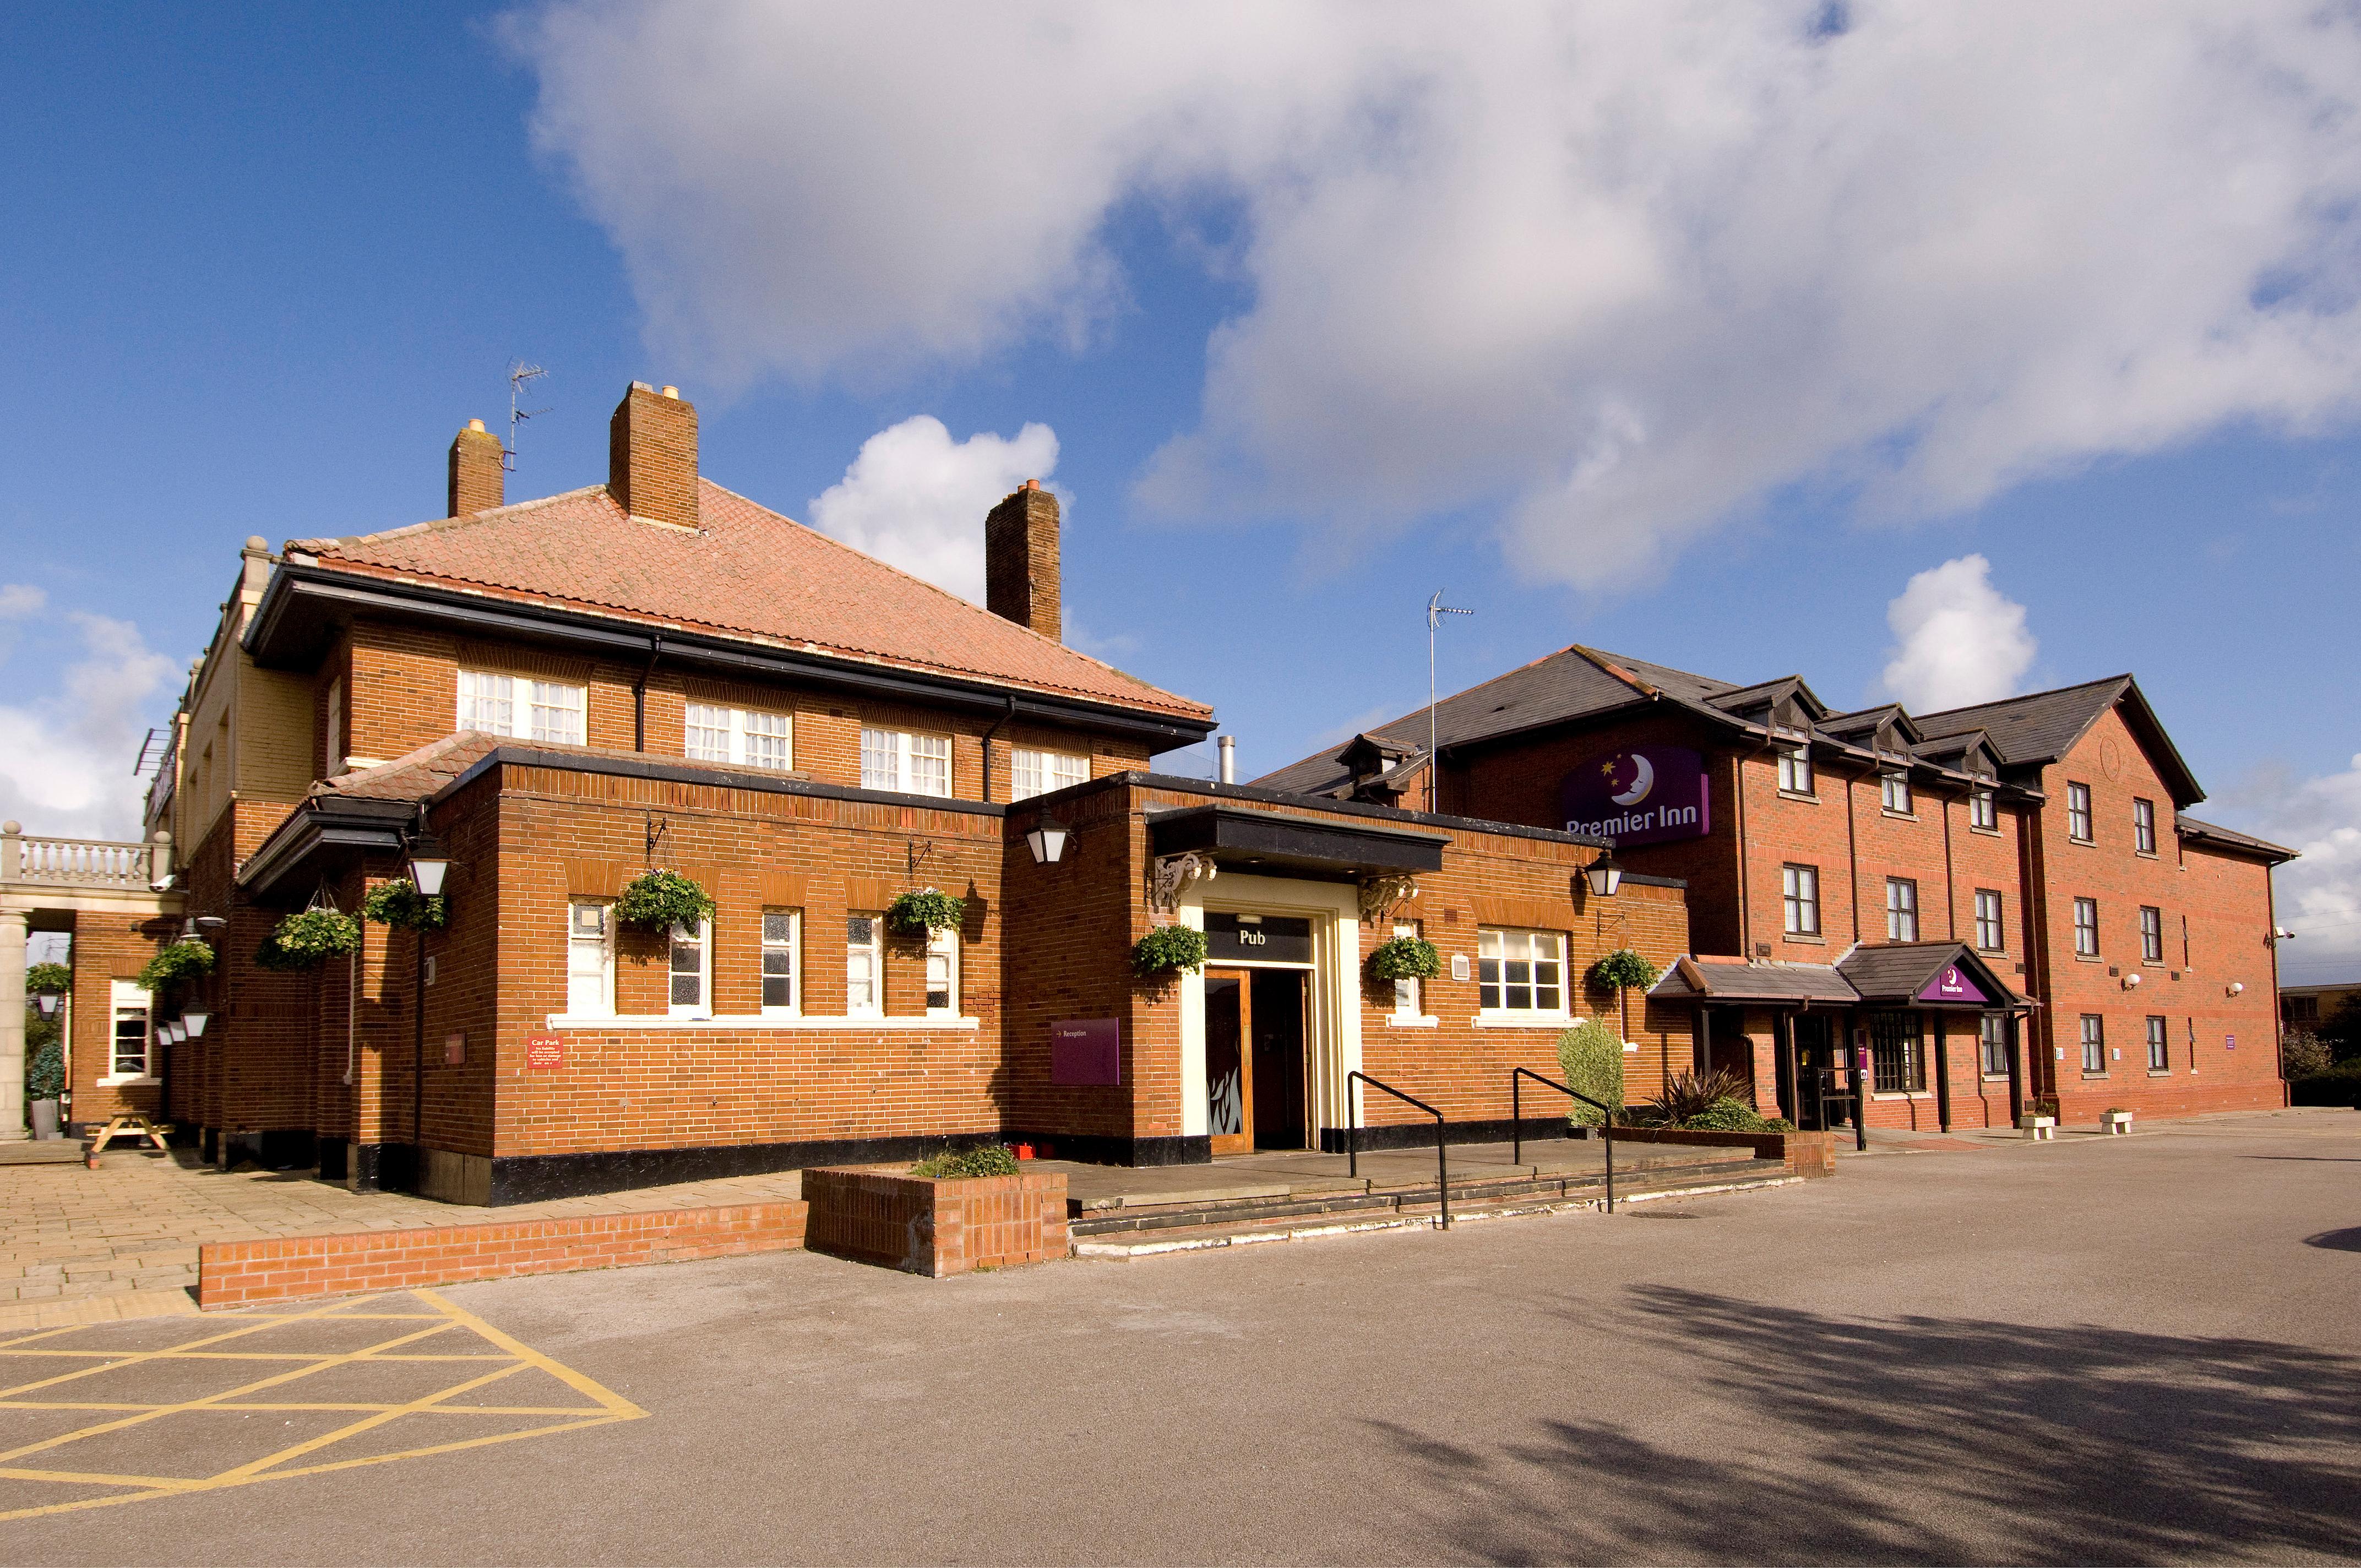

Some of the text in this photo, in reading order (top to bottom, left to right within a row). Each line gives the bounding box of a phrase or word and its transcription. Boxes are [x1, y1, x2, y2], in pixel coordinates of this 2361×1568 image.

[1566, 805, 1696, 837] Premier Inn
[1241, 930, 1266, 945] Pub
[1063, 1030, 1086, 1038] Reception
